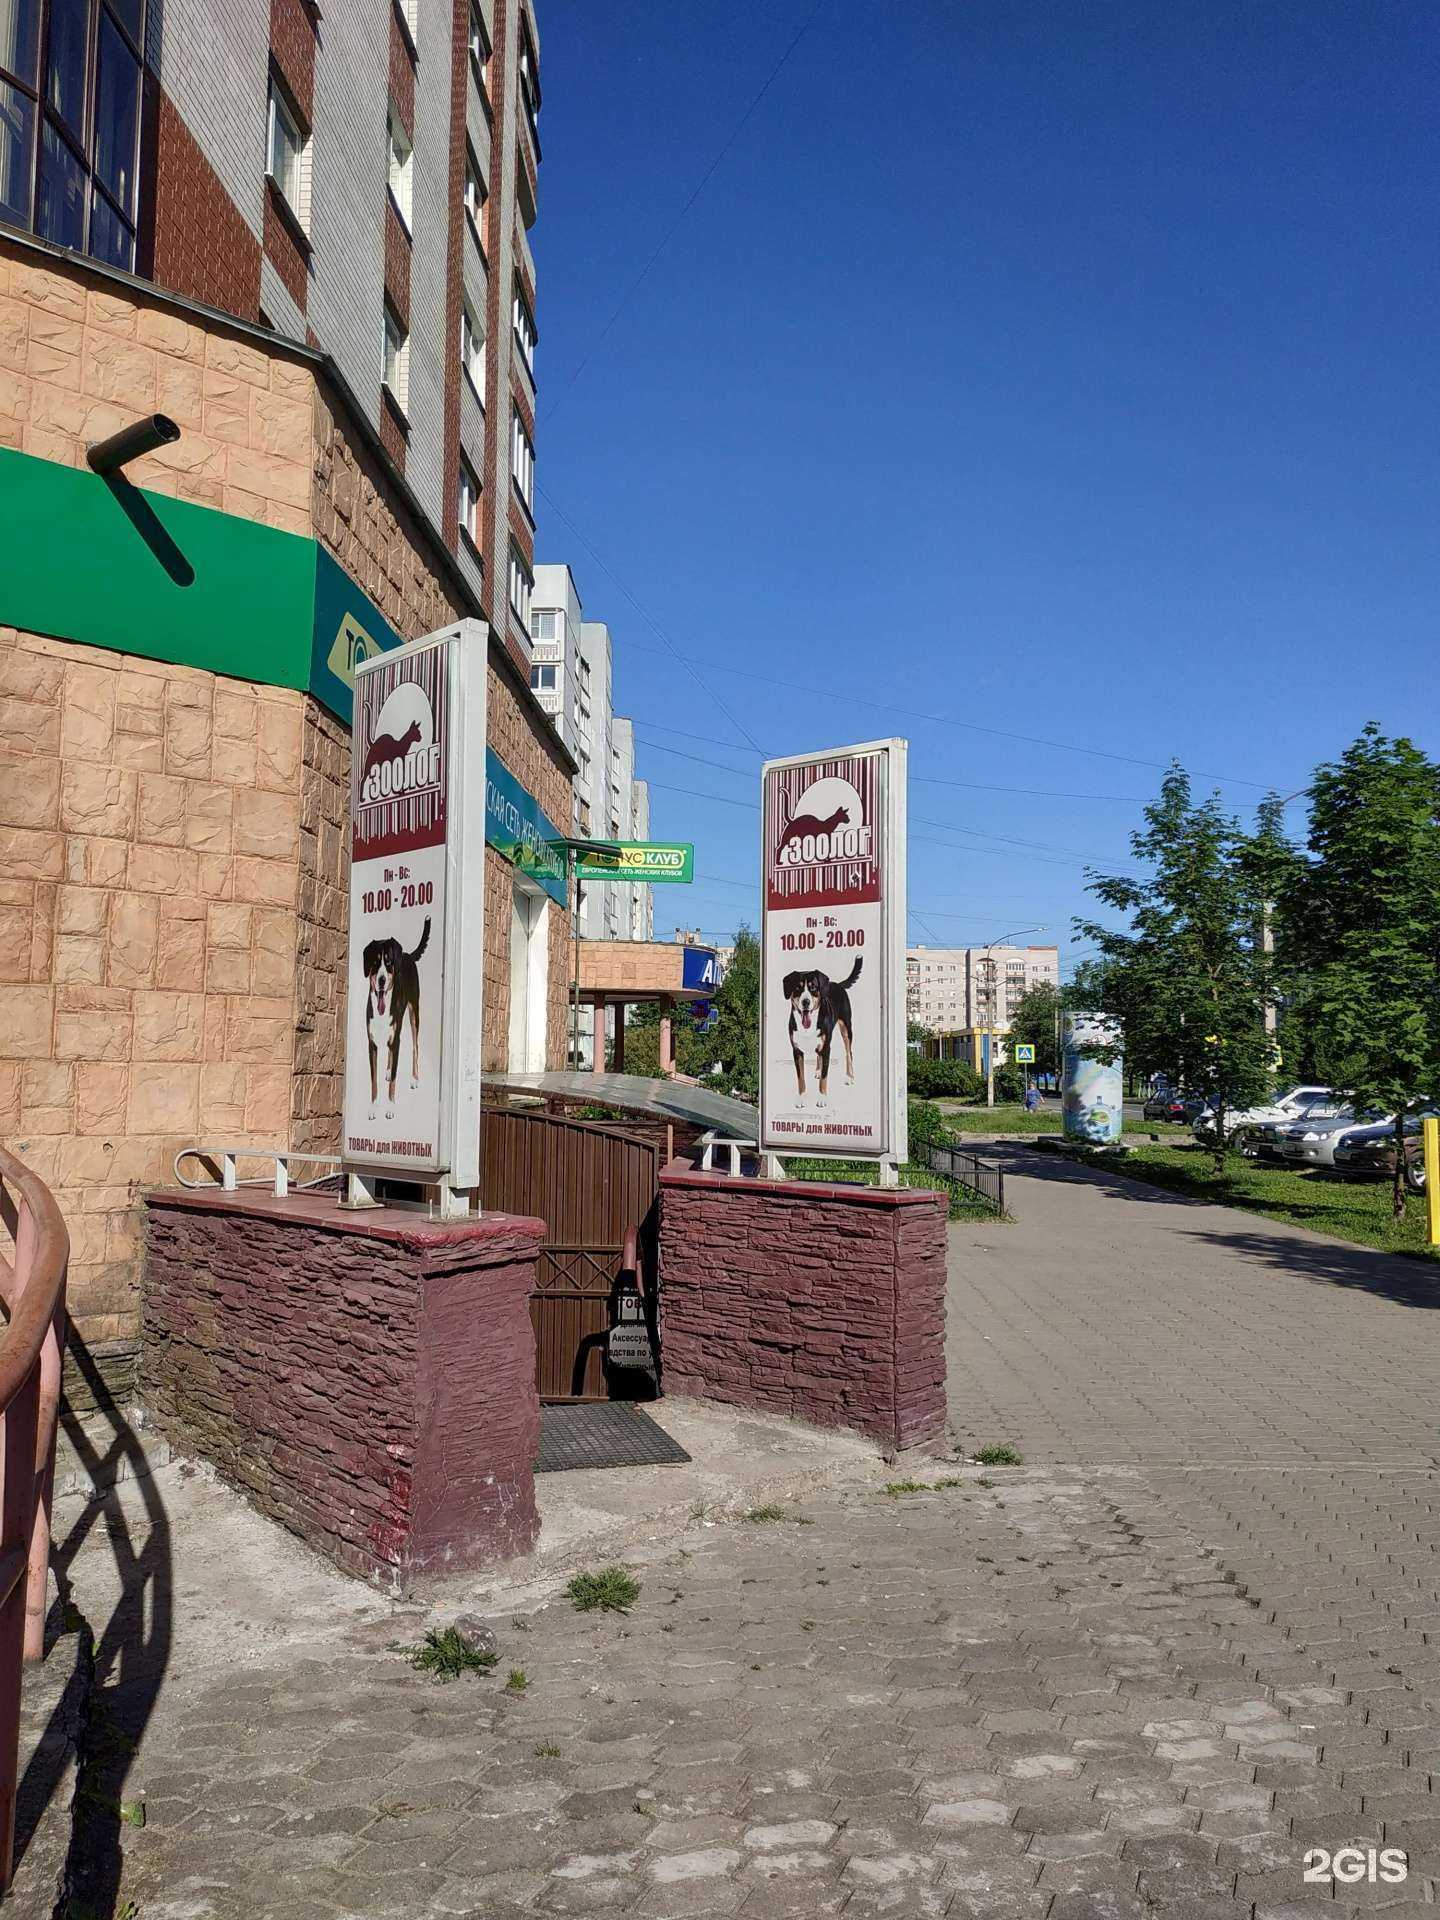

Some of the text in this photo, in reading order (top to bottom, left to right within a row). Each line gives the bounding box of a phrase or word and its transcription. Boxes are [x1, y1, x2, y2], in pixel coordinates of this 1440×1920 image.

[345, 628, 373, 674] ТО
[369, 742, 441, 801] ЗООЛОГ
[485, 778, 505, 825] СКАЯ
[505, 802, 521, 838] СЕТЬ
[788, 825, 872, 863] ЗООЛОГ
[646, 852, 680, 865] КЛУБ
[384, 869, 394, 883] Пн
[399, 866, 411, 880] Вс:
[362, 888, 391, 914] 10.00
[400, 881, 433, 908] 20.00
[806, 917, 818, 928] Пн
[824, 916, 838, 927] Вс:
[780, 932, 815, 950] 10.00
[826, 929, 865, 948] 20.00
[771, 1121, 872, 1136] ТОВАРЫ для ЖИВОТНЫХ
[348, 1137, 432, 1158] ТОВАРЫ для ЖИВОТНЫХ
